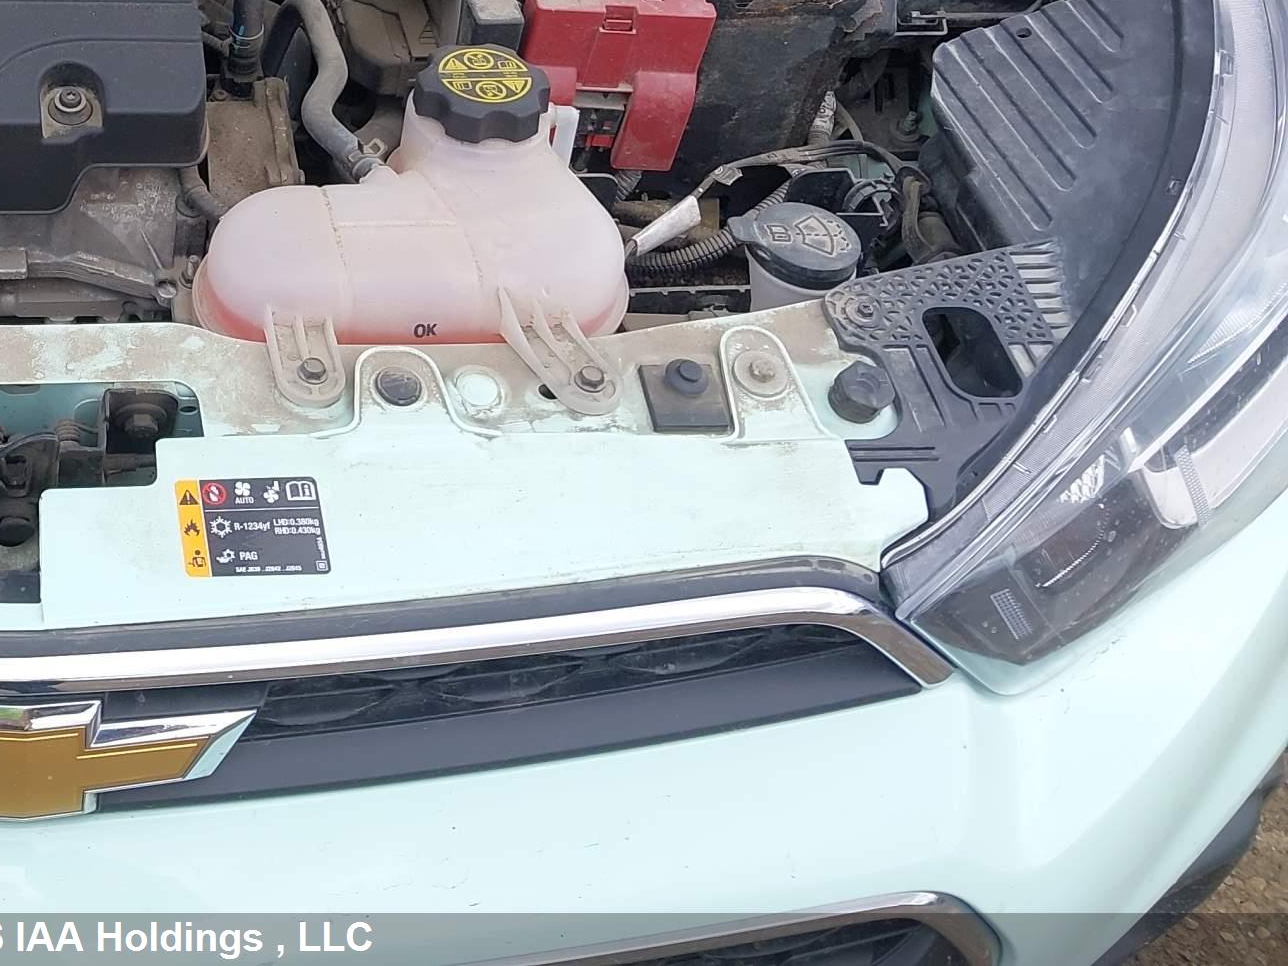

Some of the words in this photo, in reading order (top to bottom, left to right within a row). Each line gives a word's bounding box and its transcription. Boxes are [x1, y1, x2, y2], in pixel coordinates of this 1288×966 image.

[413, 323, 438, 339] OK
[235, 497, 254, 505] AUTO
[233, 521, 271, 532] R-1234yf
[239, 551, 258, 561] PAG
